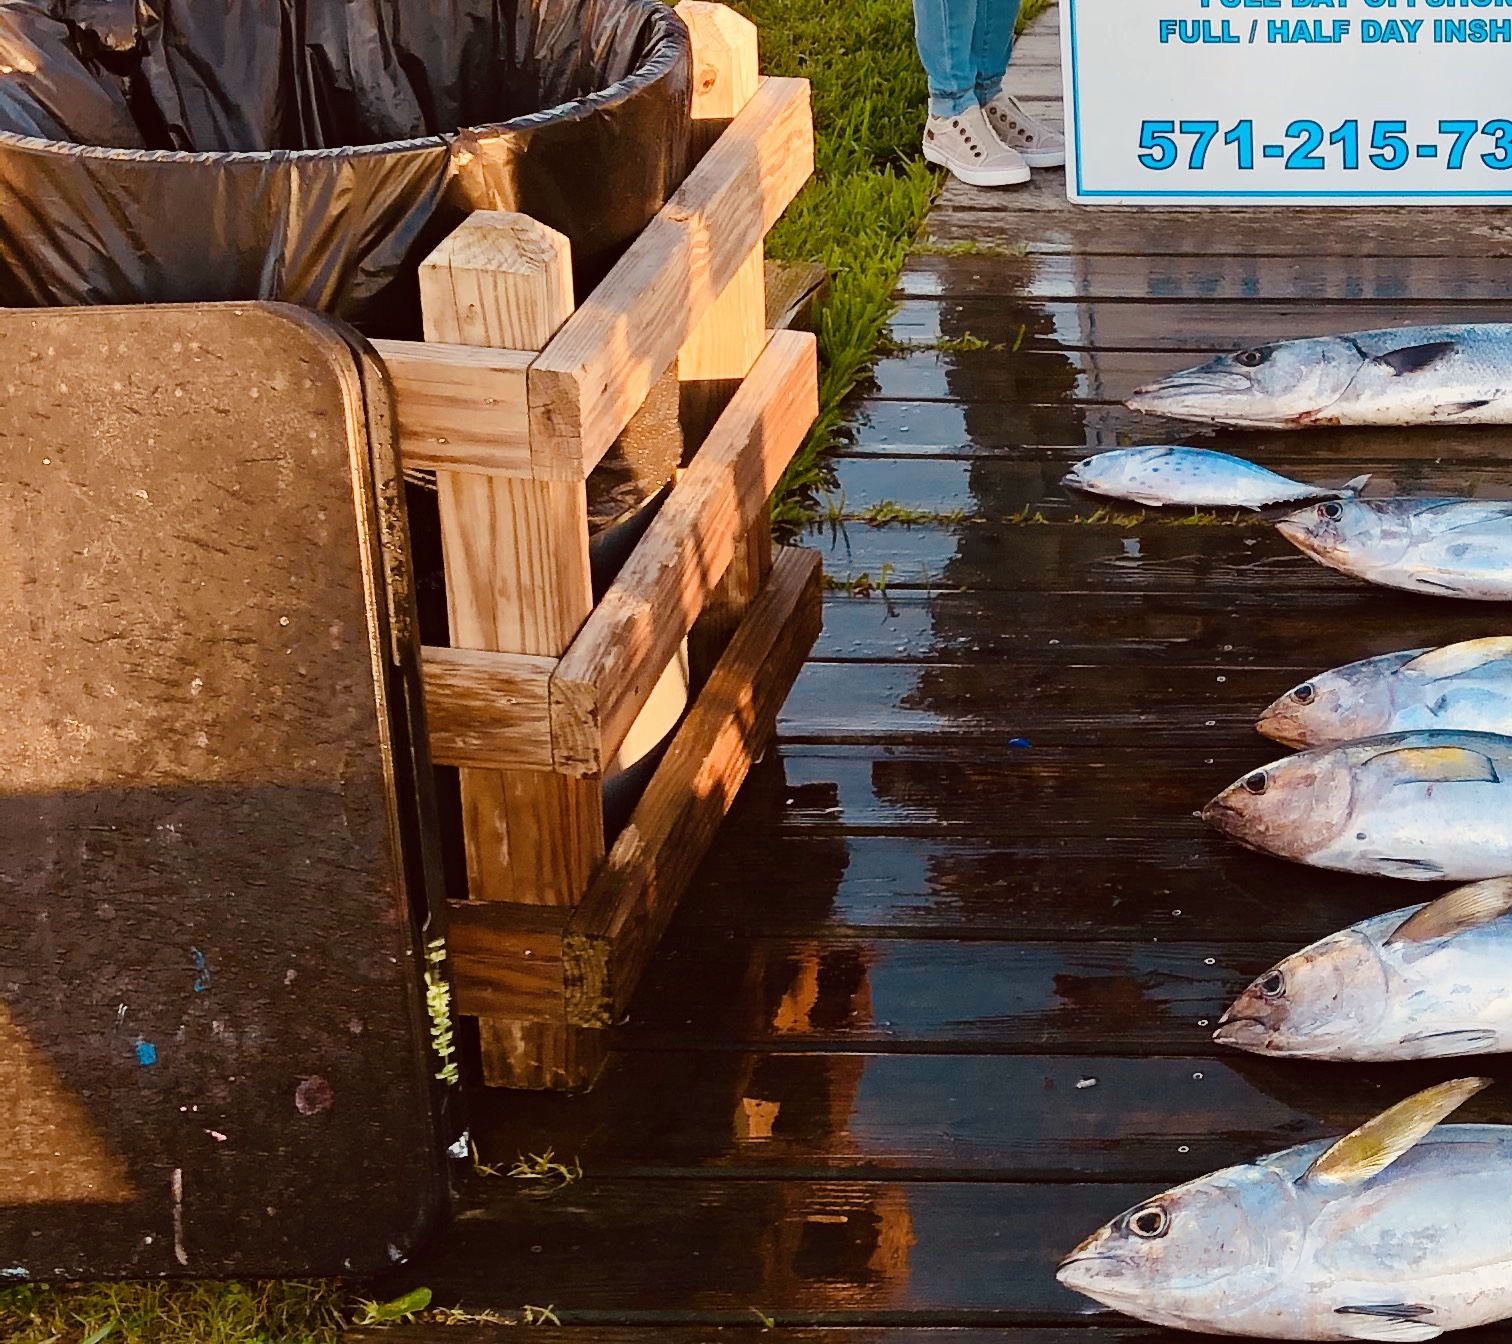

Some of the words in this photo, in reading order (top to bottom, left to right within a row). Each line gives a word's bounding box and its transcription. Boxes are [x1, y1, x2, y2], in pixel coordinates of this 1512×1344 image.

[1160, 19, 1240, 43] FULL
[1248, 19, 1259, 43] /
[1268, 19, 1350, 43] HALF
[1360, 19, 1424, 43] DAY
